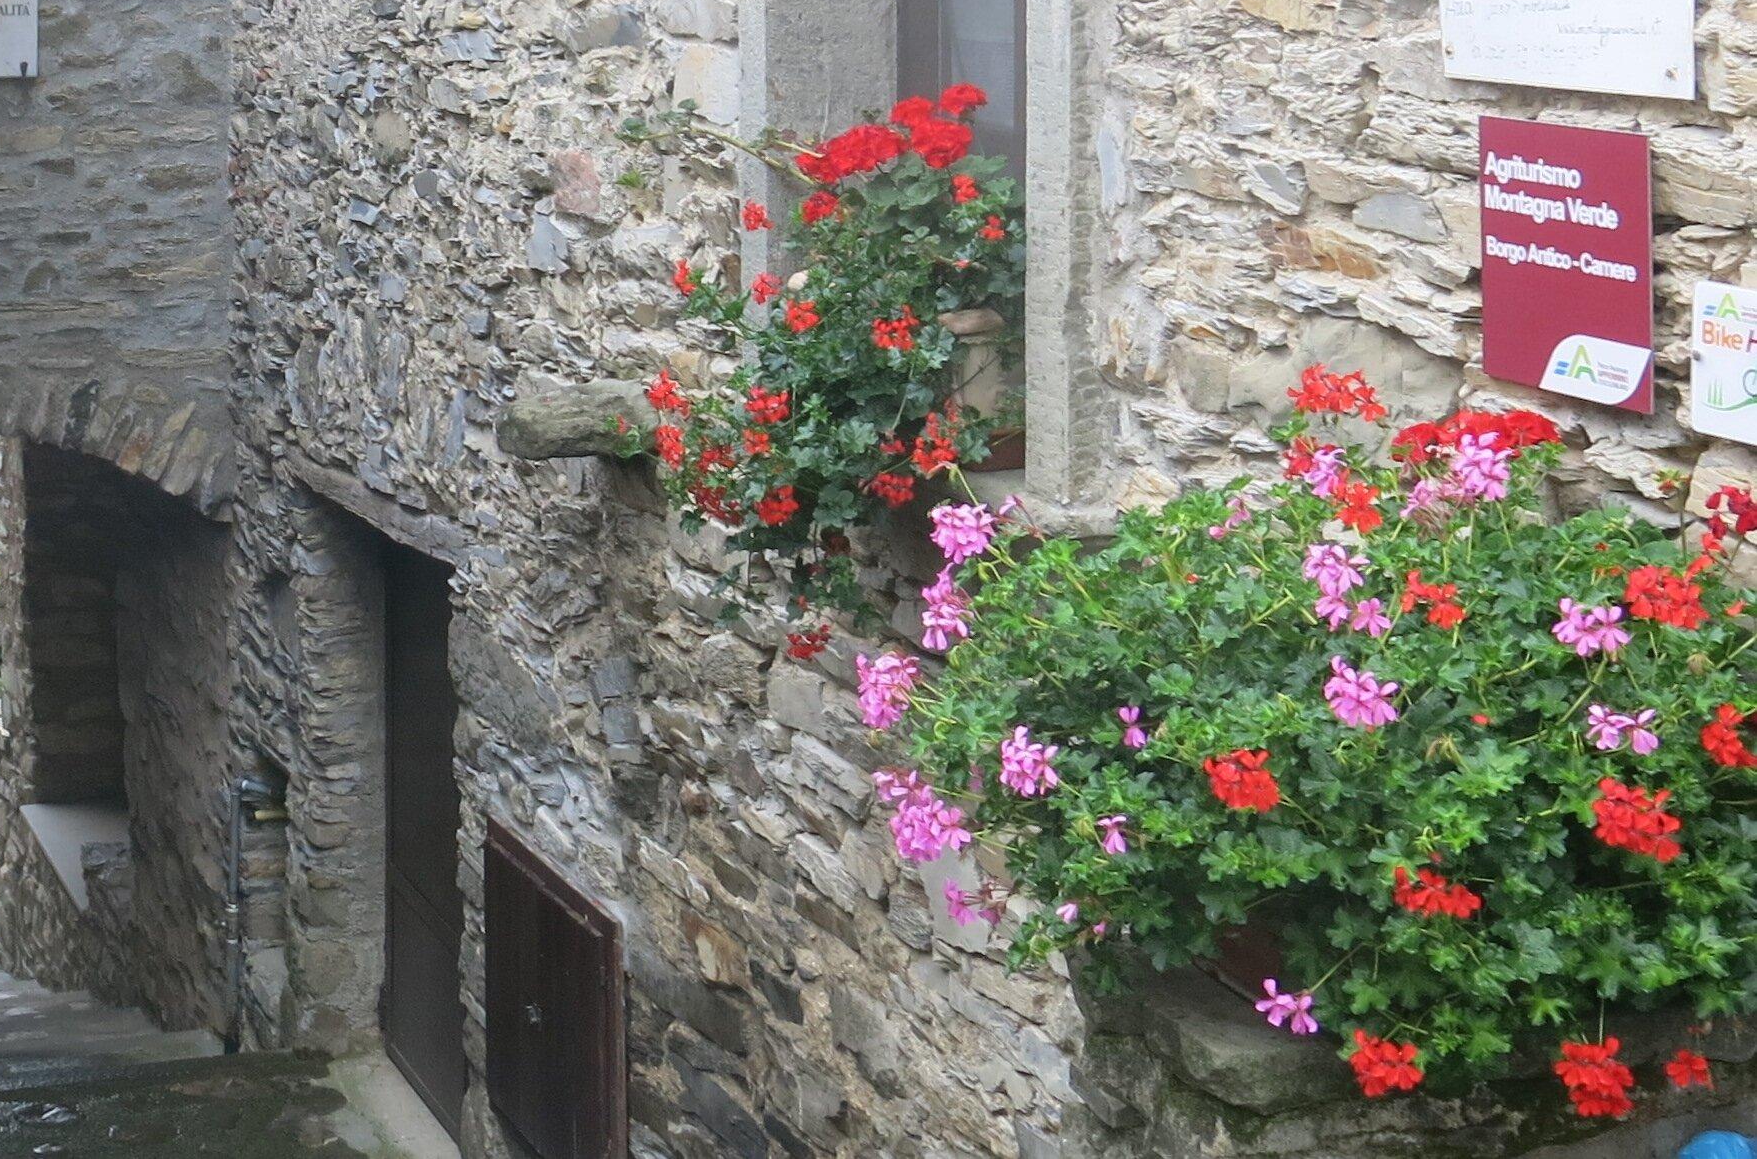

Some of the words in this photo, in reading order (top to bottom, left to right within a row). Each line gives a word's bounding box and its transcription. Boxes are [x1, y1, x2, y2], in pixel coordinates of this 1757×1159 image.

[1484, 150, 1582, 189] Agriturismo
[1484, 183, 1566, 224] Montagna
[1565, 196, 1619, 230] Verde
[1485, 234, 1527, 265] Borgo
[1527, 242, 1573, 270] Antico
[1580, 252, 1637, 283] Camere
[1701, 319, 1743, 351] Bike
